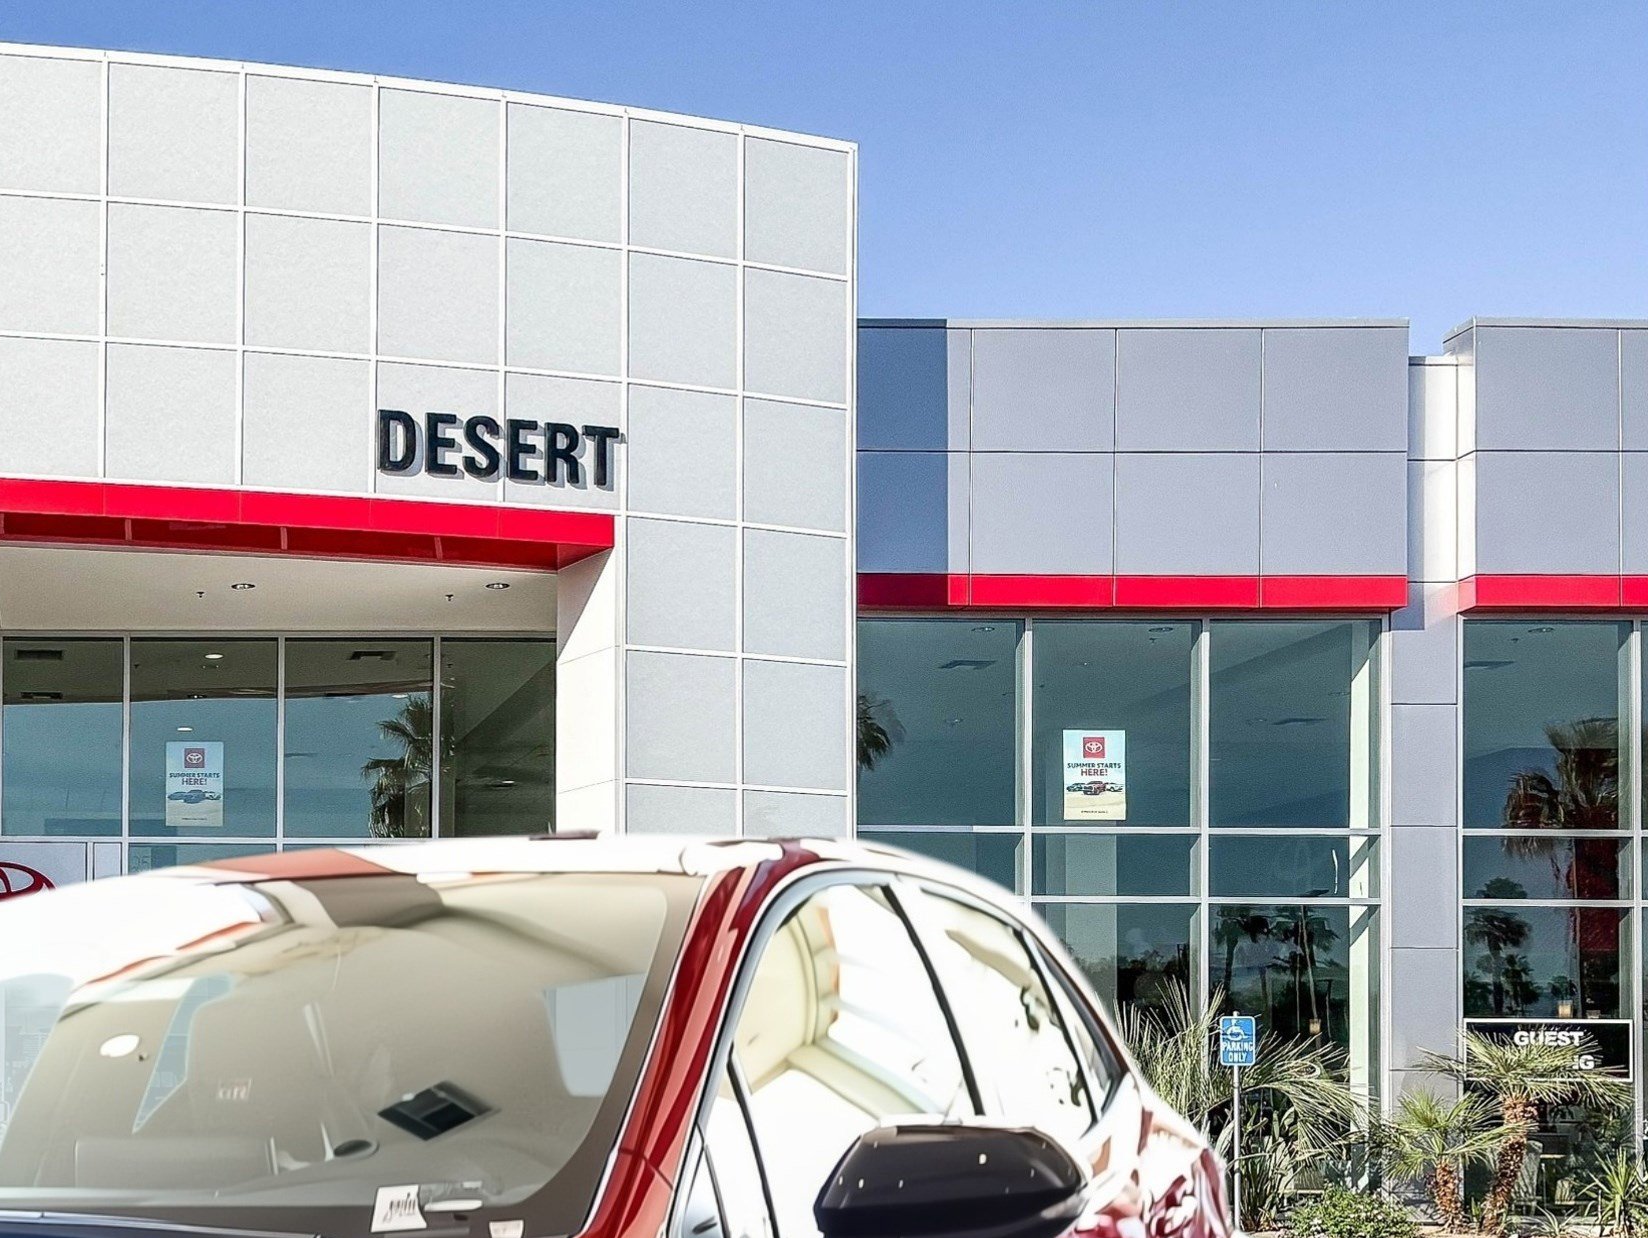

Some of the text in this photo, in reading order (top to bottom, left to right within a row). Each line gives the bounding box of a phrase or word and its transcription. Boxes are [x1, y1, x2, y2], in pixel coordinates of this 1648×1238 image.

[377, 409, 621, 487] DESERT
[1080, 768, 1108, 776] HERE!
[181, 778, 208, 786] HERE!
[1513, 1030, 1585, 1046] GUEST
[1222, 1040, 1253, 1052] PARKING
[1228, 1052, 1247, 1062] ONLY
